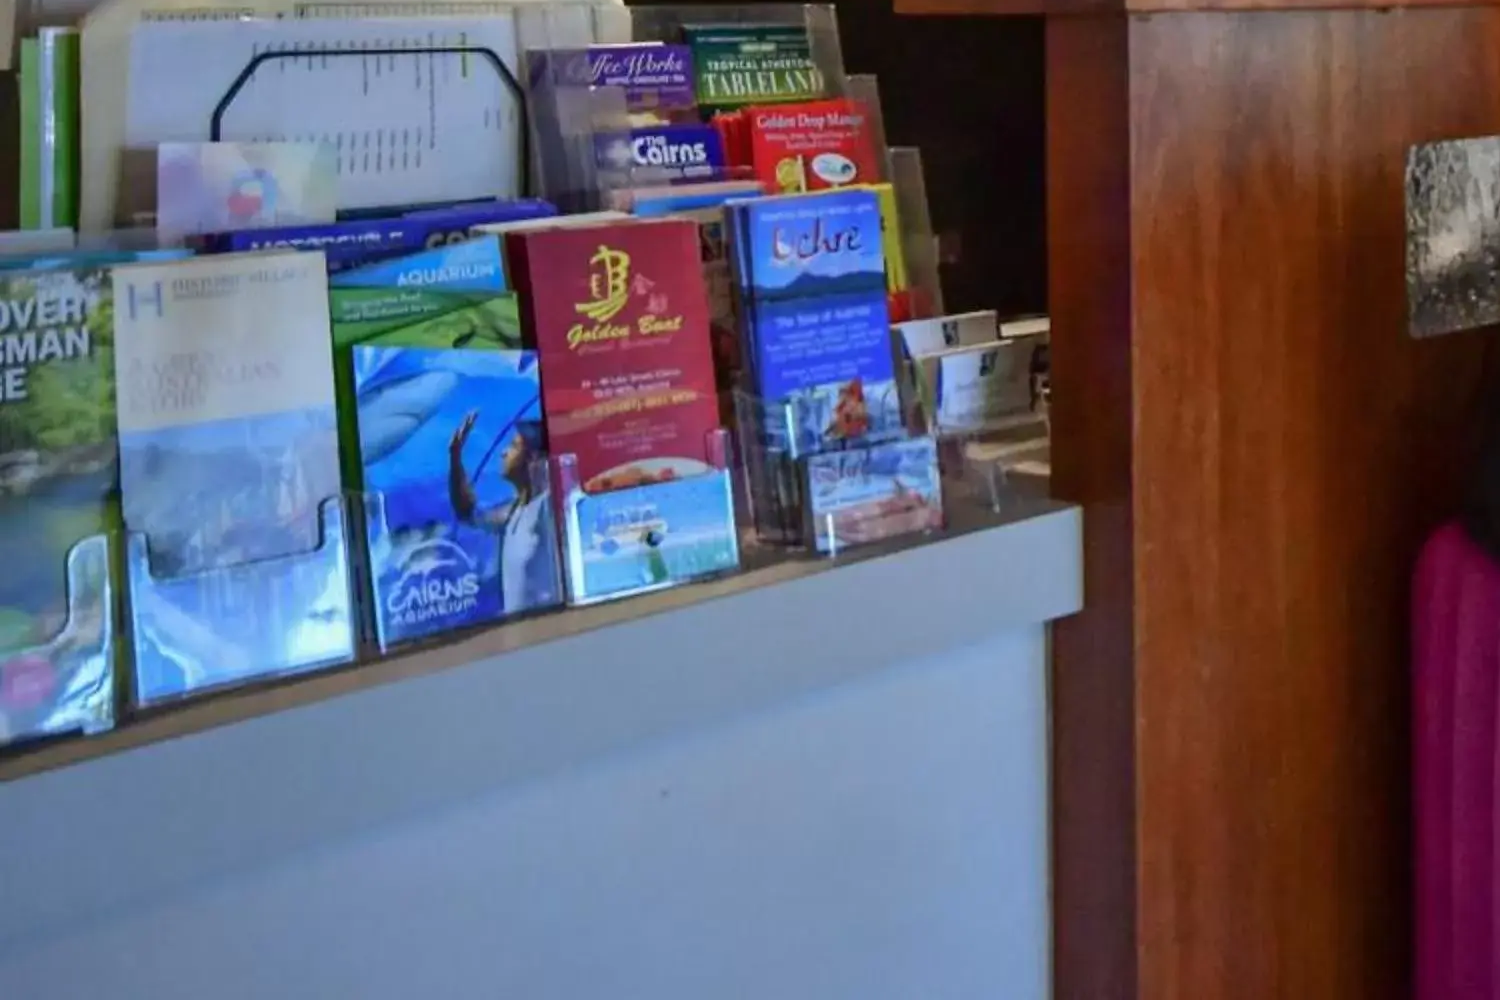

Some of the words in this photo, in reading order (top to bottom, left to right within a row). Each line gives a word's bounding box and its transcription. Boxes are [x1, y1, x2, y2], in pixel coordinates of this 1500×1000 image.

[622, 51, 684, 79] Works
[632, 137, 707, 165] Cairns
[397, 265, 496, 286] AQUARIUM
[566, 323, 630, 350] Golden
[386, 573, 480, 613] CAIRNS
